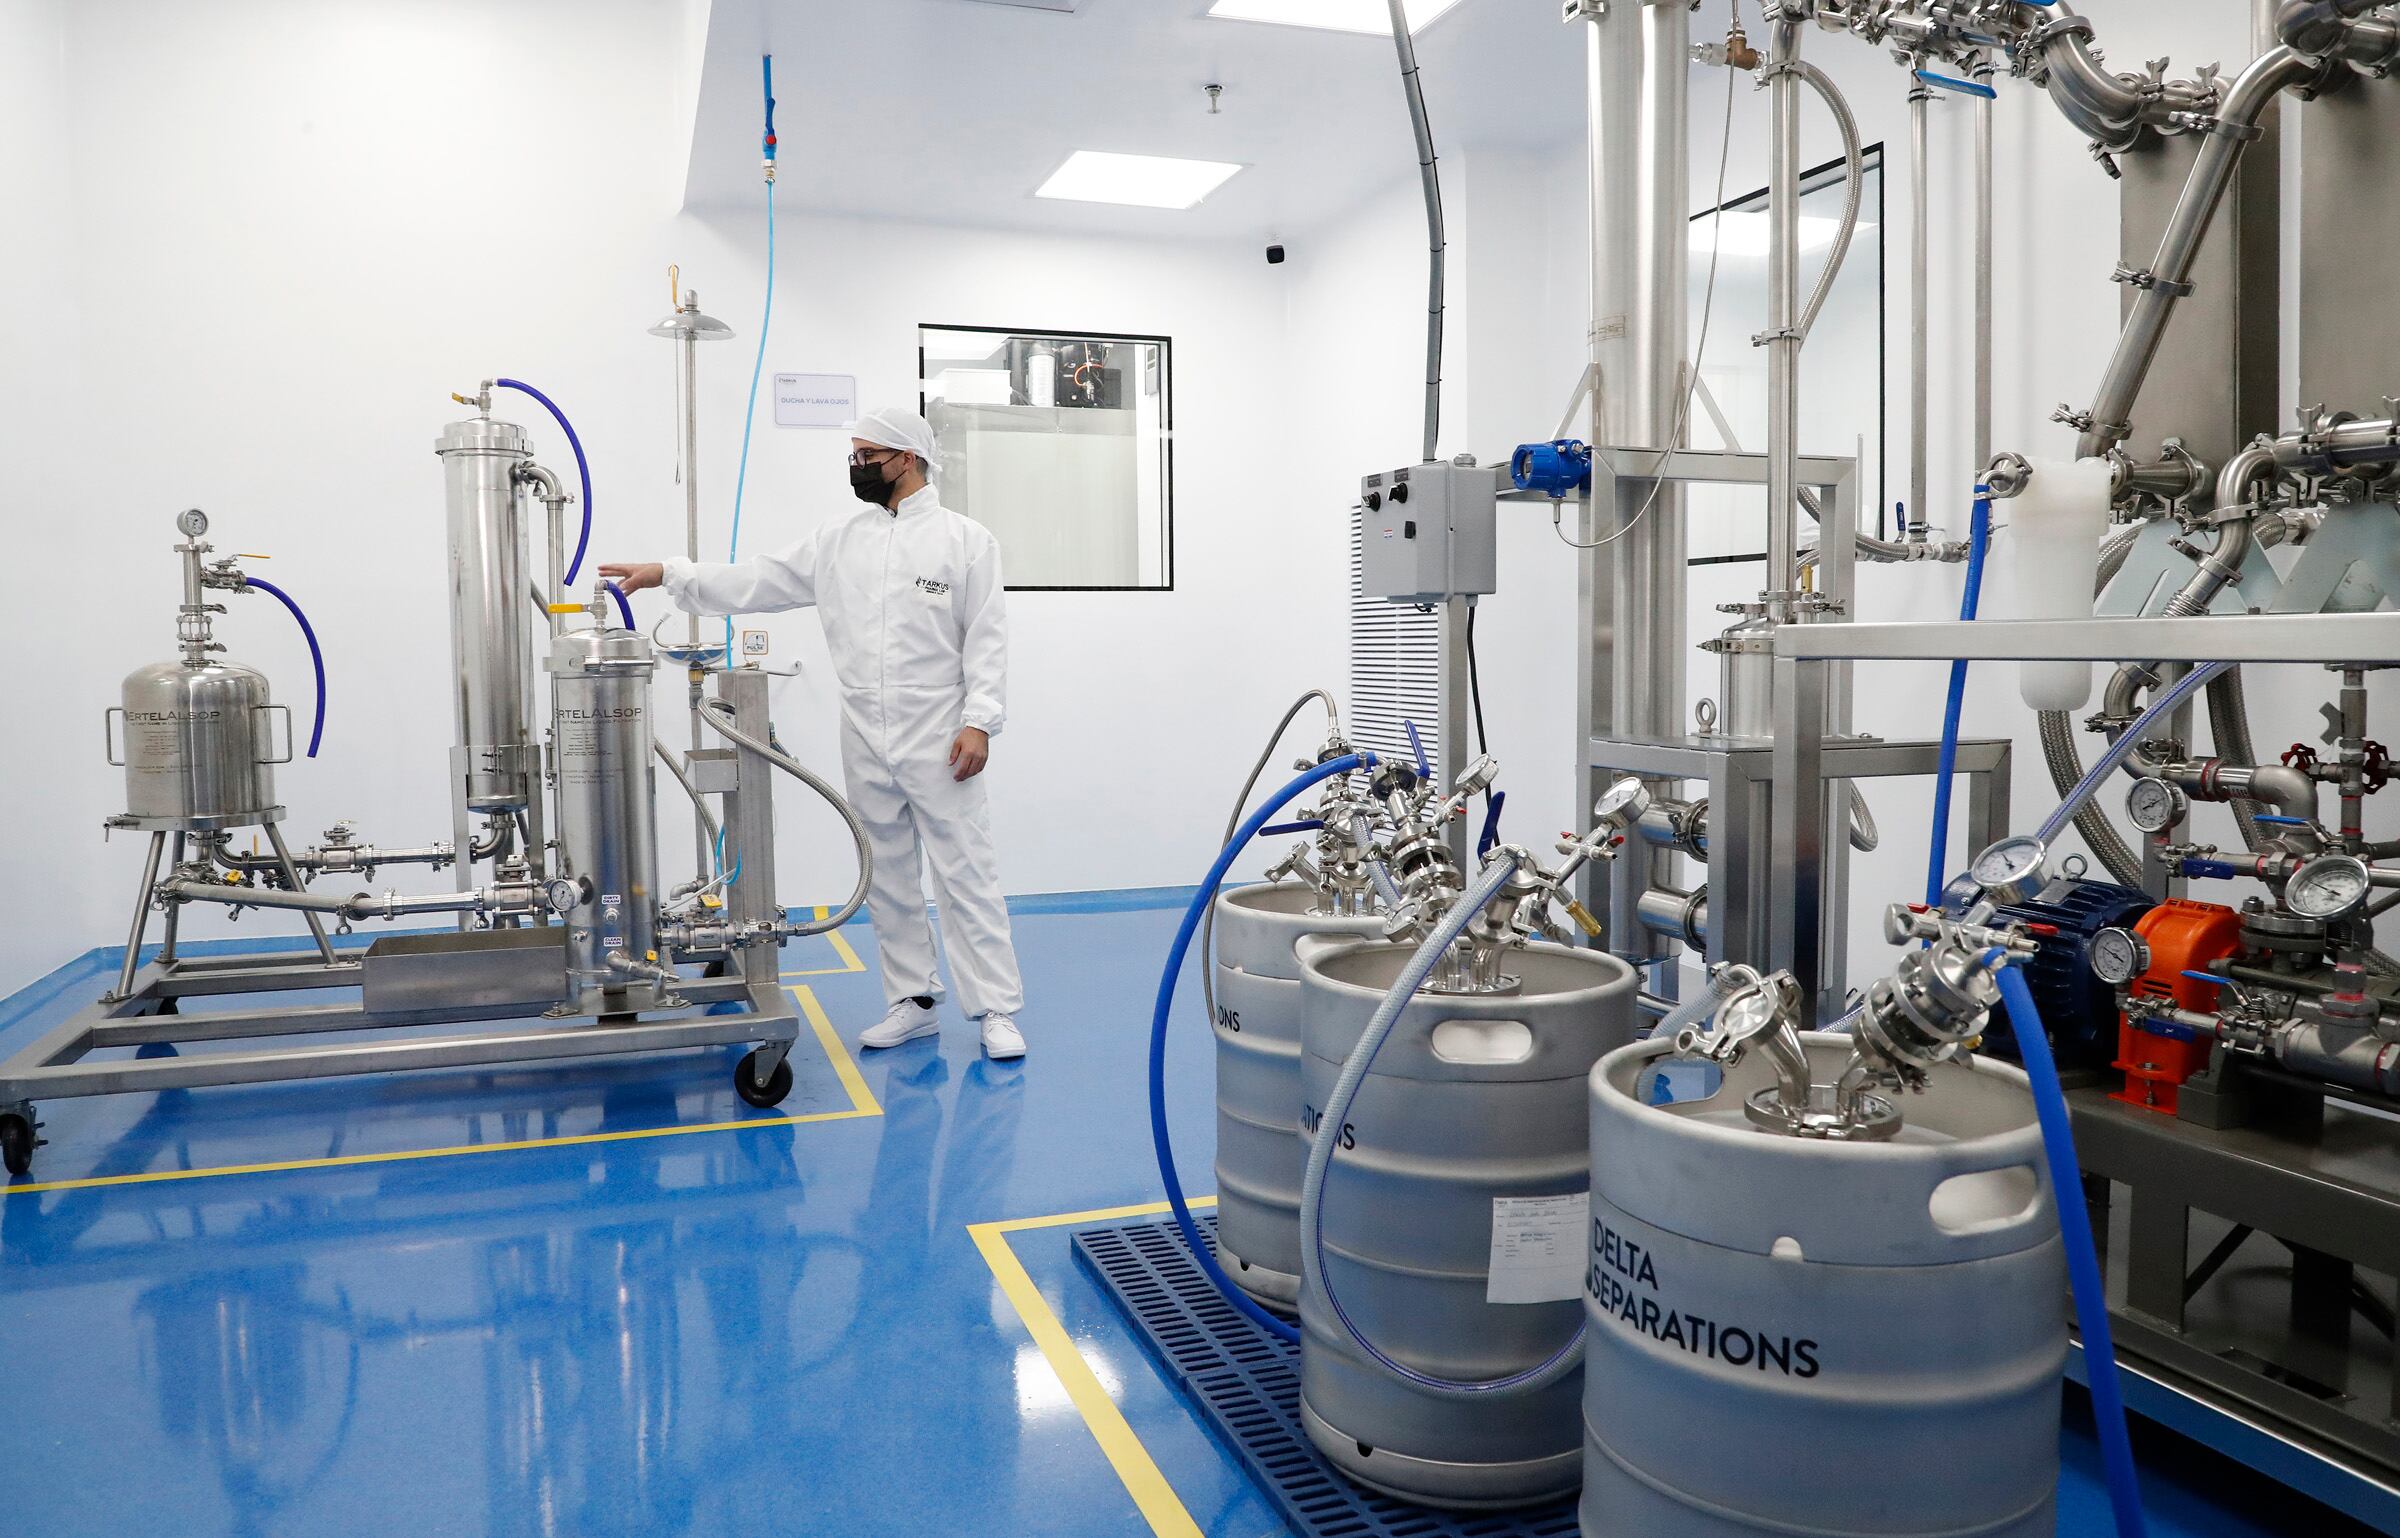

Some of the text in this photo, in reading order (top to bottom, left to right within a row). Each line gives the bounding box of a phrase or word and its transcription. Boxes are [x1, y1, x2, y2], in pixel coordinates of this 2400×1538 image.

[922, 580, 948, 590] TARKUS
[1594, 1216, 1659, 1291] DELTA
[1592, 1263, 1820, 1379] SEPARATIONS
